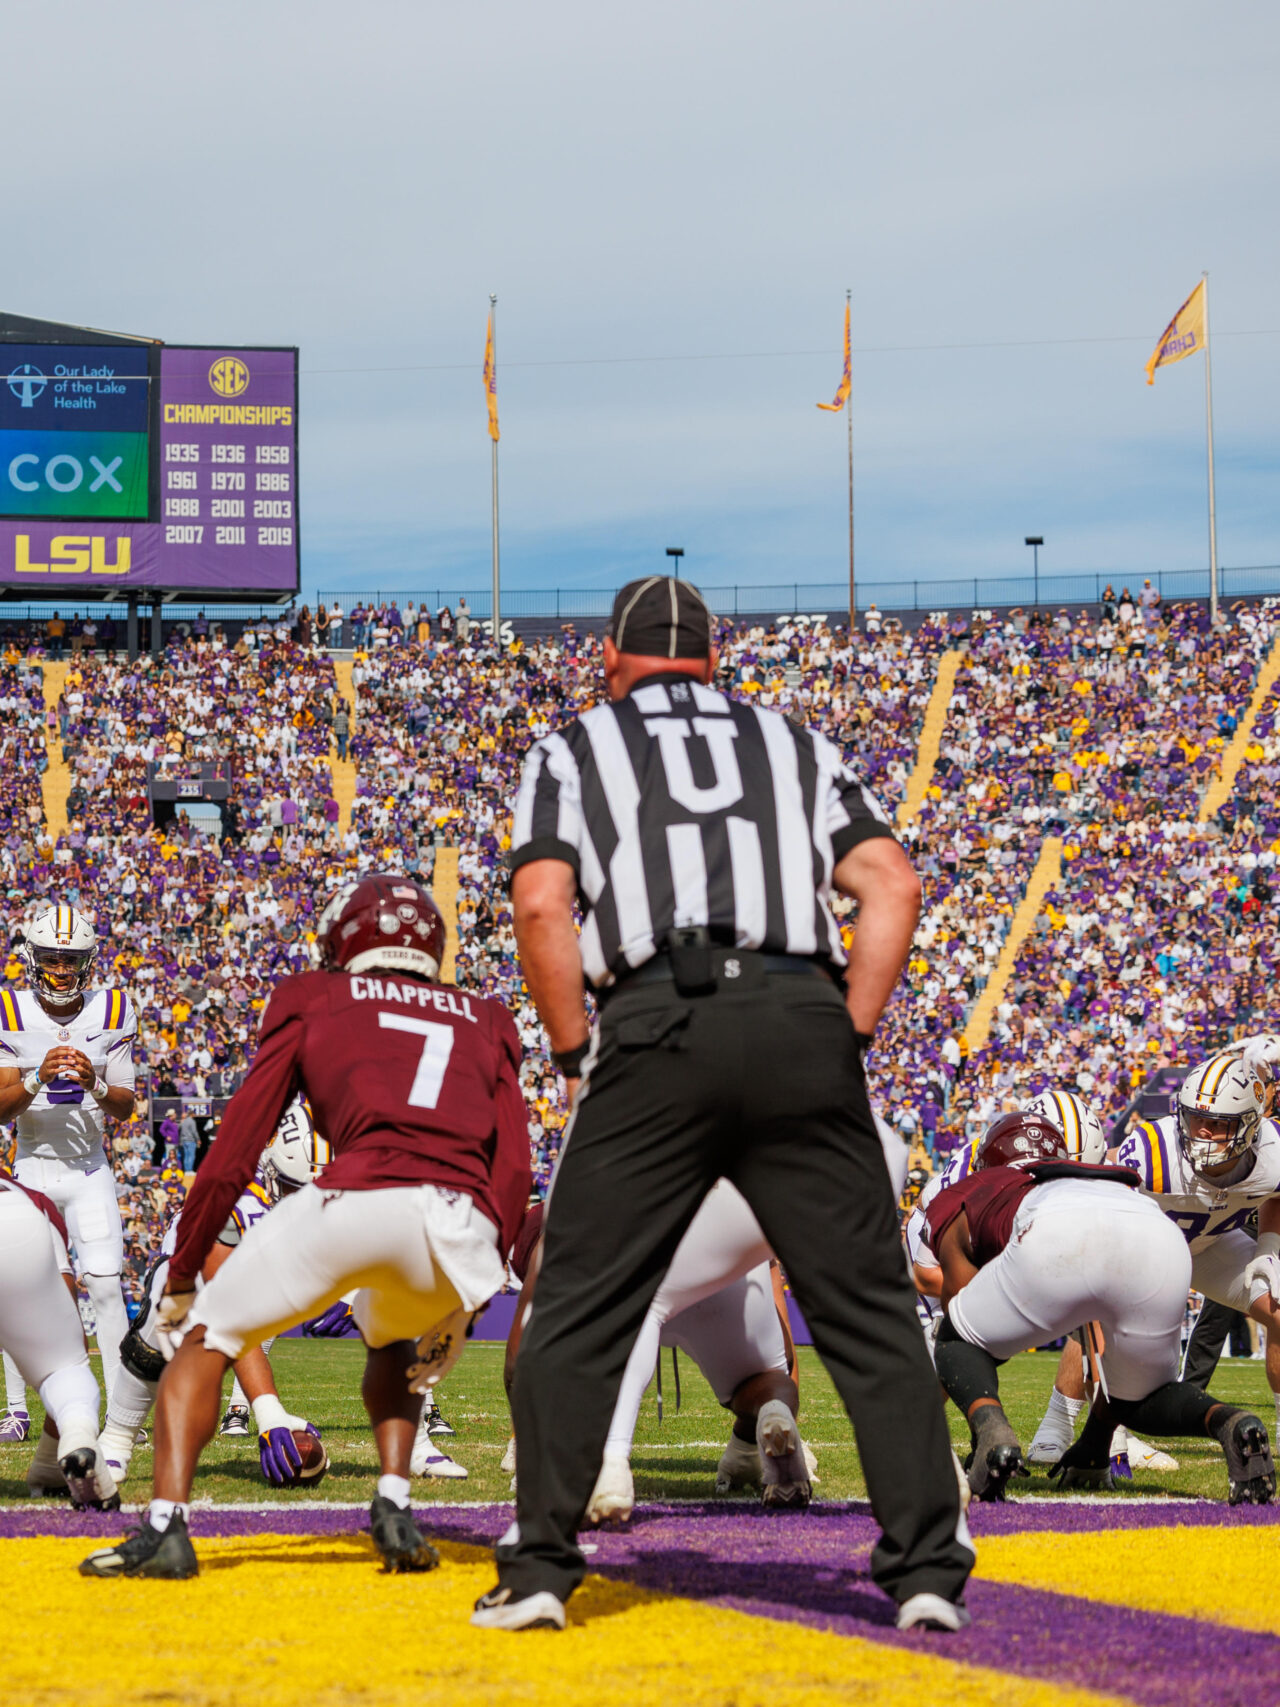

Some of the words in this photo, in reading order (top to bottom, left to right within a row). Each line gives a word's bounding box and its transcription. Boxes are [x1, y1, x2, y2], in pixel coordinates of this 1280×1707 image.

[54, 364, 79, 377] Our
[82, 364, 114, 381] Lady
[212, 359, 245, 395] SEC
[54, 381, 69, 393] of
[72, 381, 93, 393] the
[96, 382, 127, 394] Lake
[54, 397, 96, 409] Health
[163, 404, 292, 426] CHAMPIONSHIPS
[165, 443, 200, 462] 1935
[211, 444, 246, 463] 1936
[255, 446, 290, 464] 1958
[8, 454, 123, 493] COX
[167, 471, 197, 490] 1961
[211, 472, 246, 491] 1970
[255, 473, 290, 492] 1986
[165, 498, 200, 517] 1988
[211, 499, 245, 518] 2001
[253, 500, 292, 518] 2003
[165, 525, 204, 544] 2007
[215, 526, 246, 545] 2011
[257, 527, 292, 546] 2019
[14, 534, 132, 575] LSU
[642, 716, 744, 814] U
[402, 934, 412, 947] 7
[349, 976, 479, 1023] CHAPPELL
[378, 1011, 455, 1110] 7
